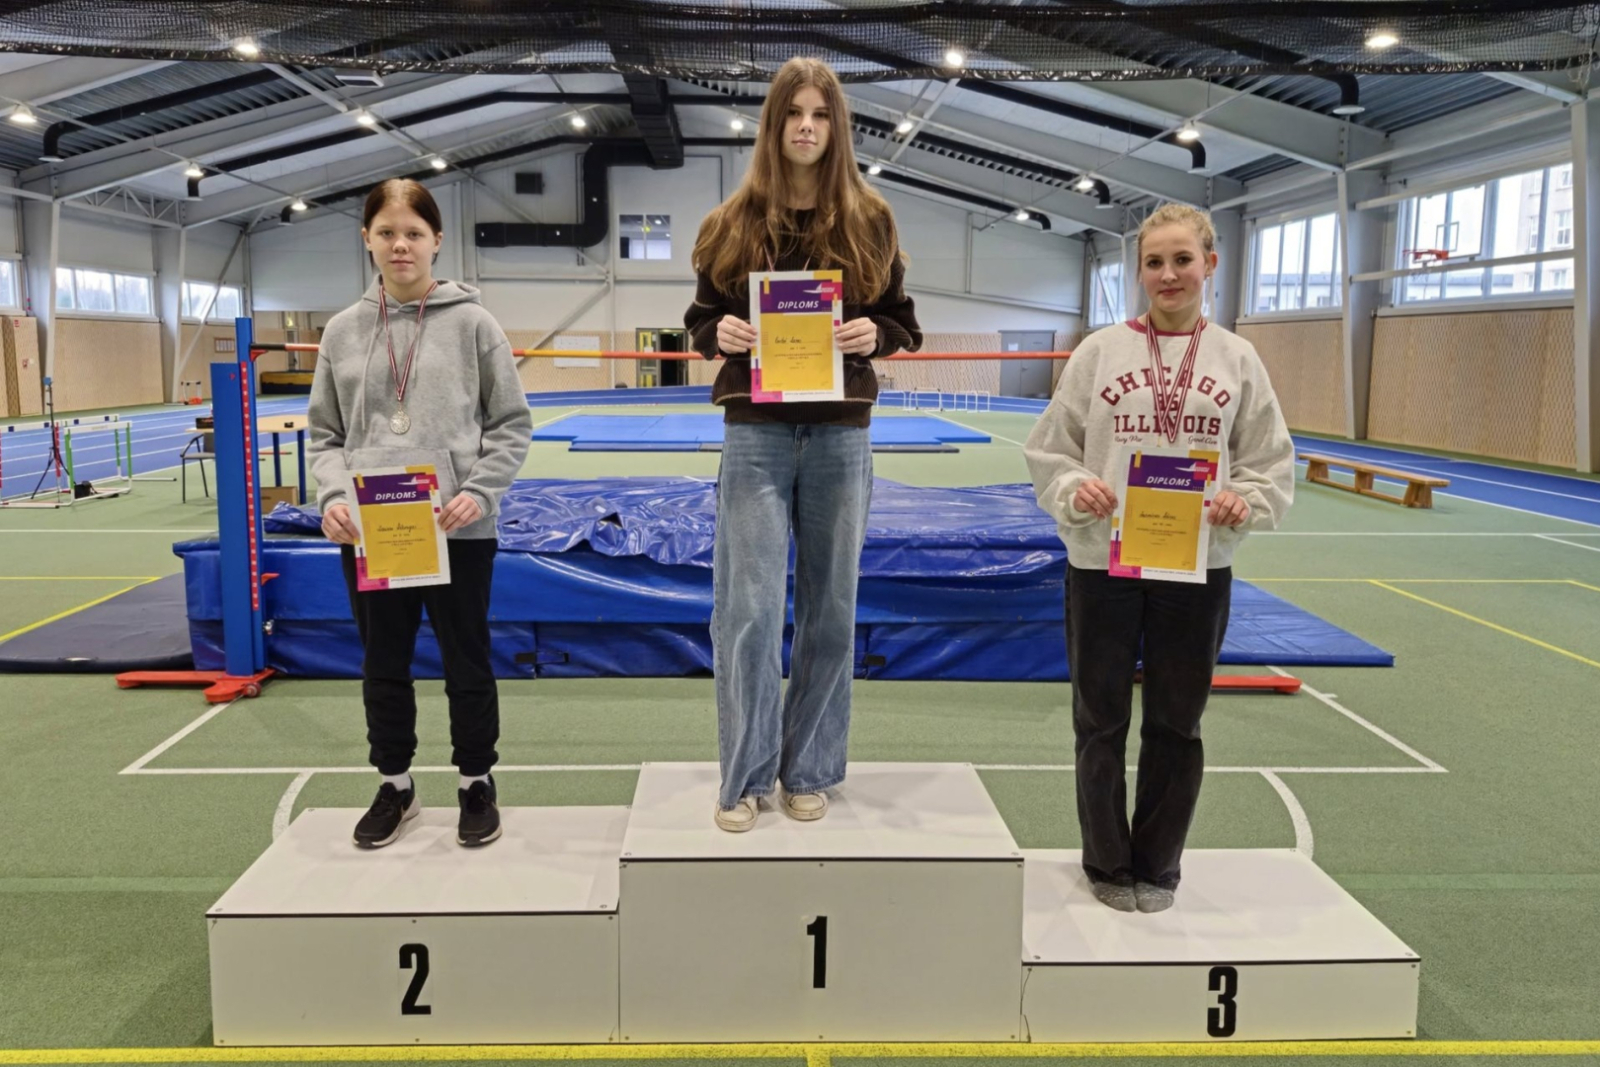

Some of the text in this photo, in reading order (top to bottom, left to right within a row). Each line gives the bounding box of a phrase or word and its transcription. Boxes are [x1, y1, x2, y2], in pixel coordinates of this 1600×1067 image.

[777, 300, 819, 309] DIPLOMS
[1100, 366, 1231, 408] CHICAGO
[1114, 415, 1221, 435] ILLINOIS
[375, 491, 417, 501] DIPLOMS
[1146, 476, 1191, 487] DIPLOMS
[807, 915, 828, 988] 1
[399, 943, 431, 1015] 2
[1207, 966, 1238, 1037] 3
